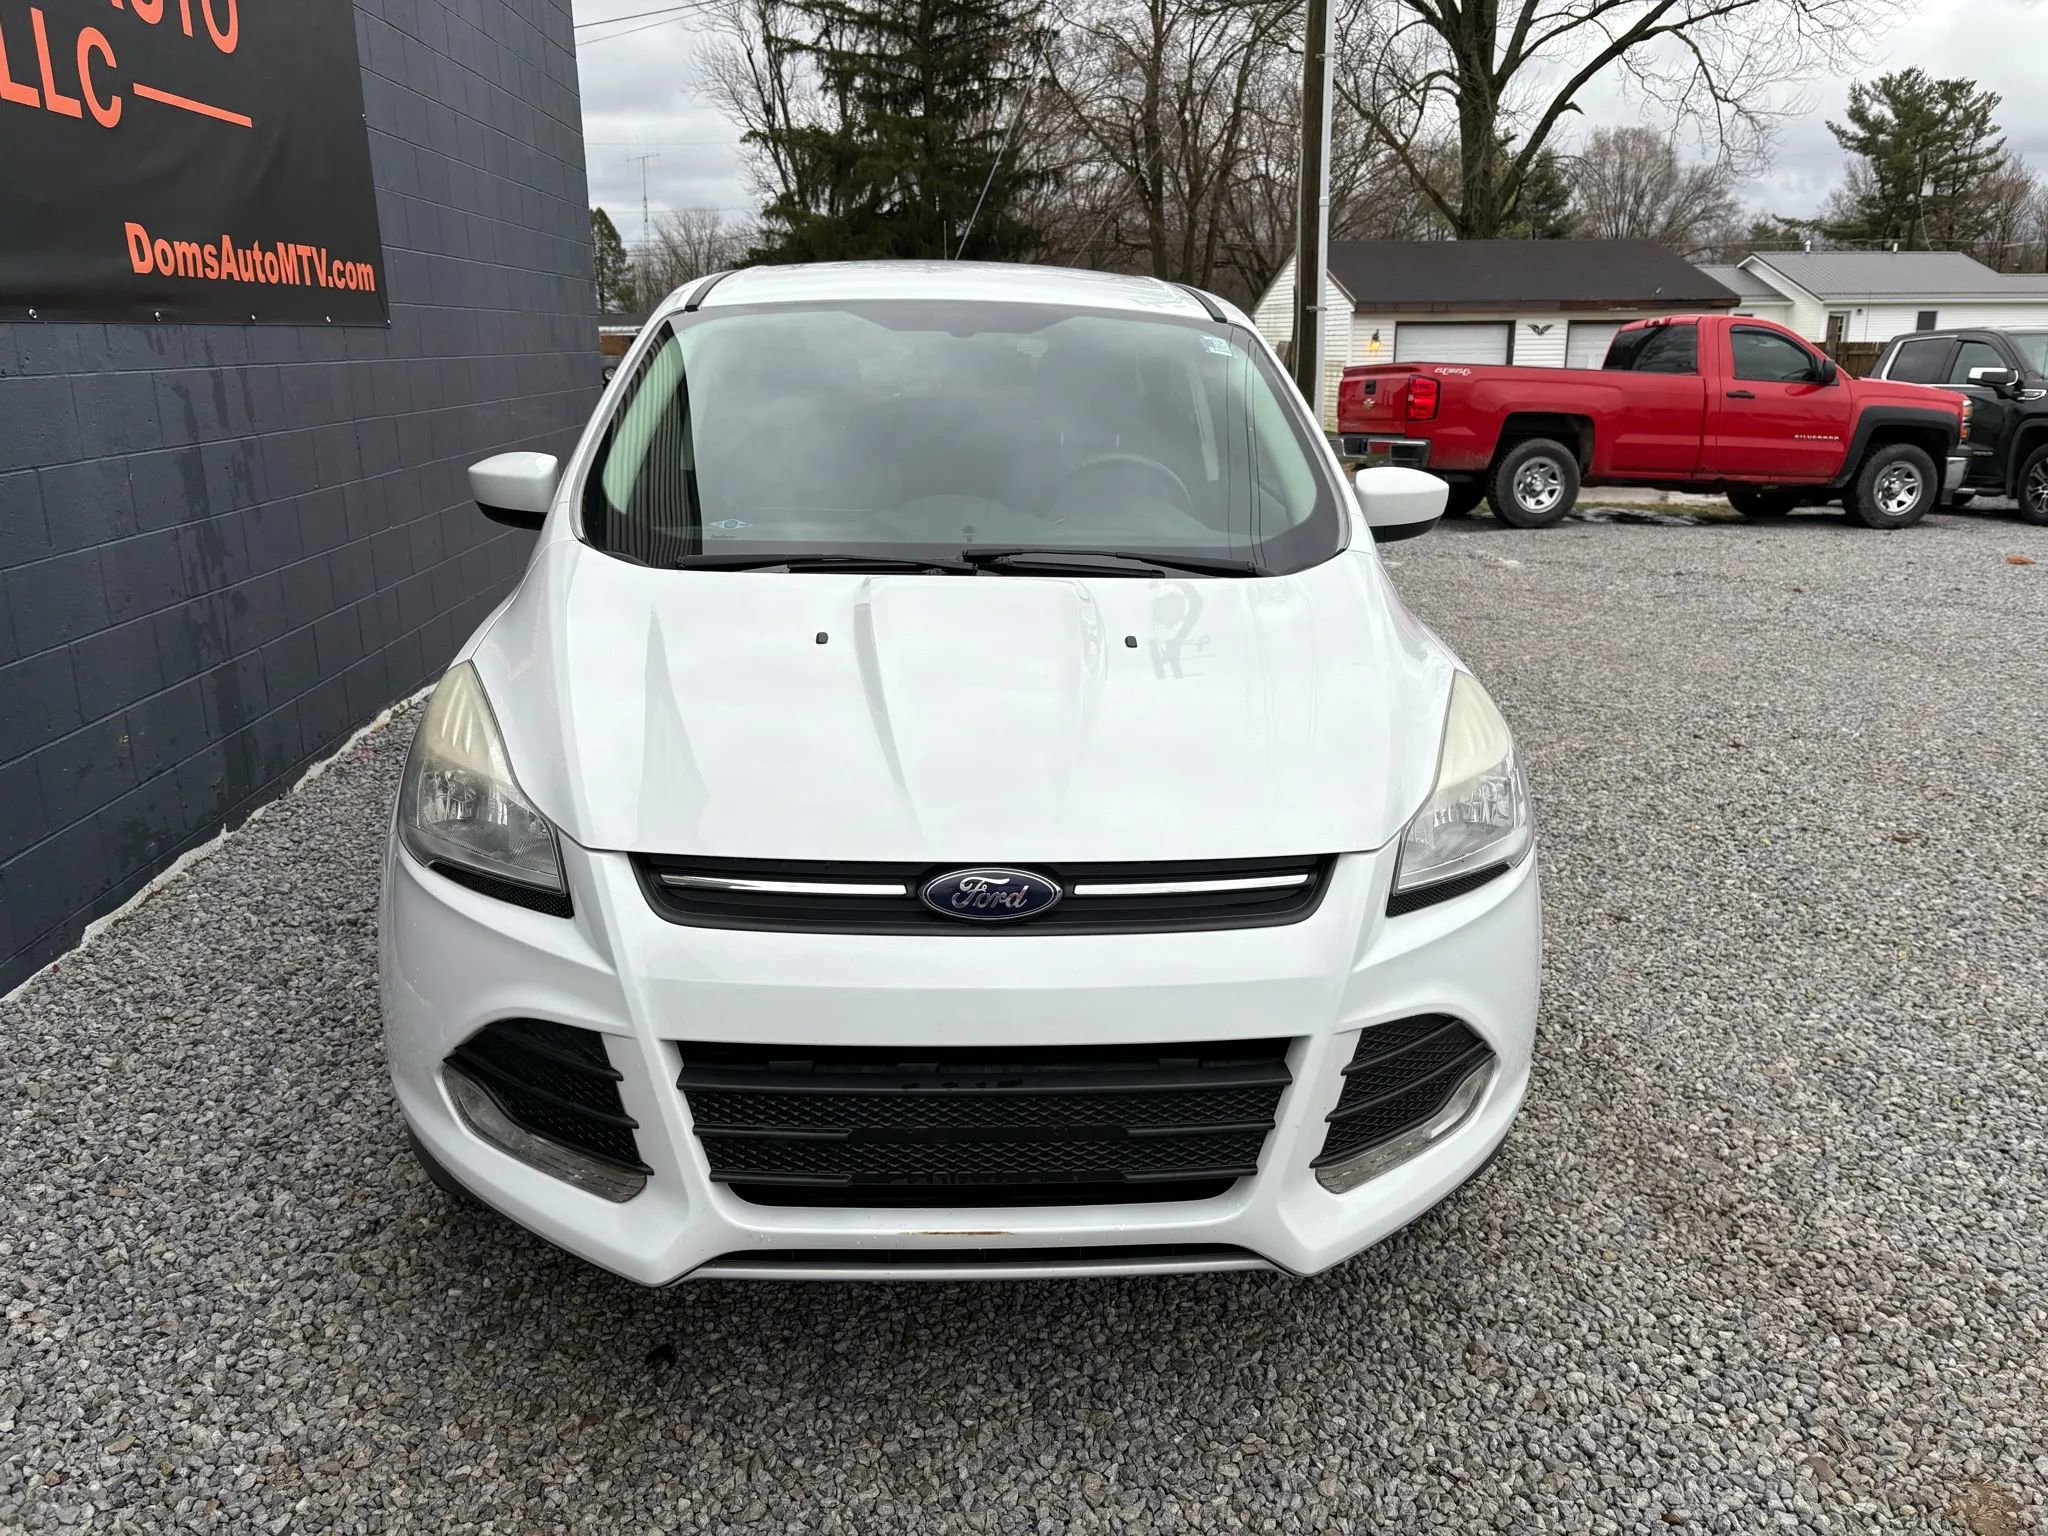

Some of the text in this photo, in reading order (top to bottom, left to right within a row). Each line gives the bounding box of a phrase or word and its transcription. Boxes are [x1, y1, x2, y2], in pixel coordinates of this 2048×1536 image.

[0, 8, 122, 128] LLC
[124, 221, 376, 292] DomsAutoMTV.com
[951, 876, 1029, 909] Ford
